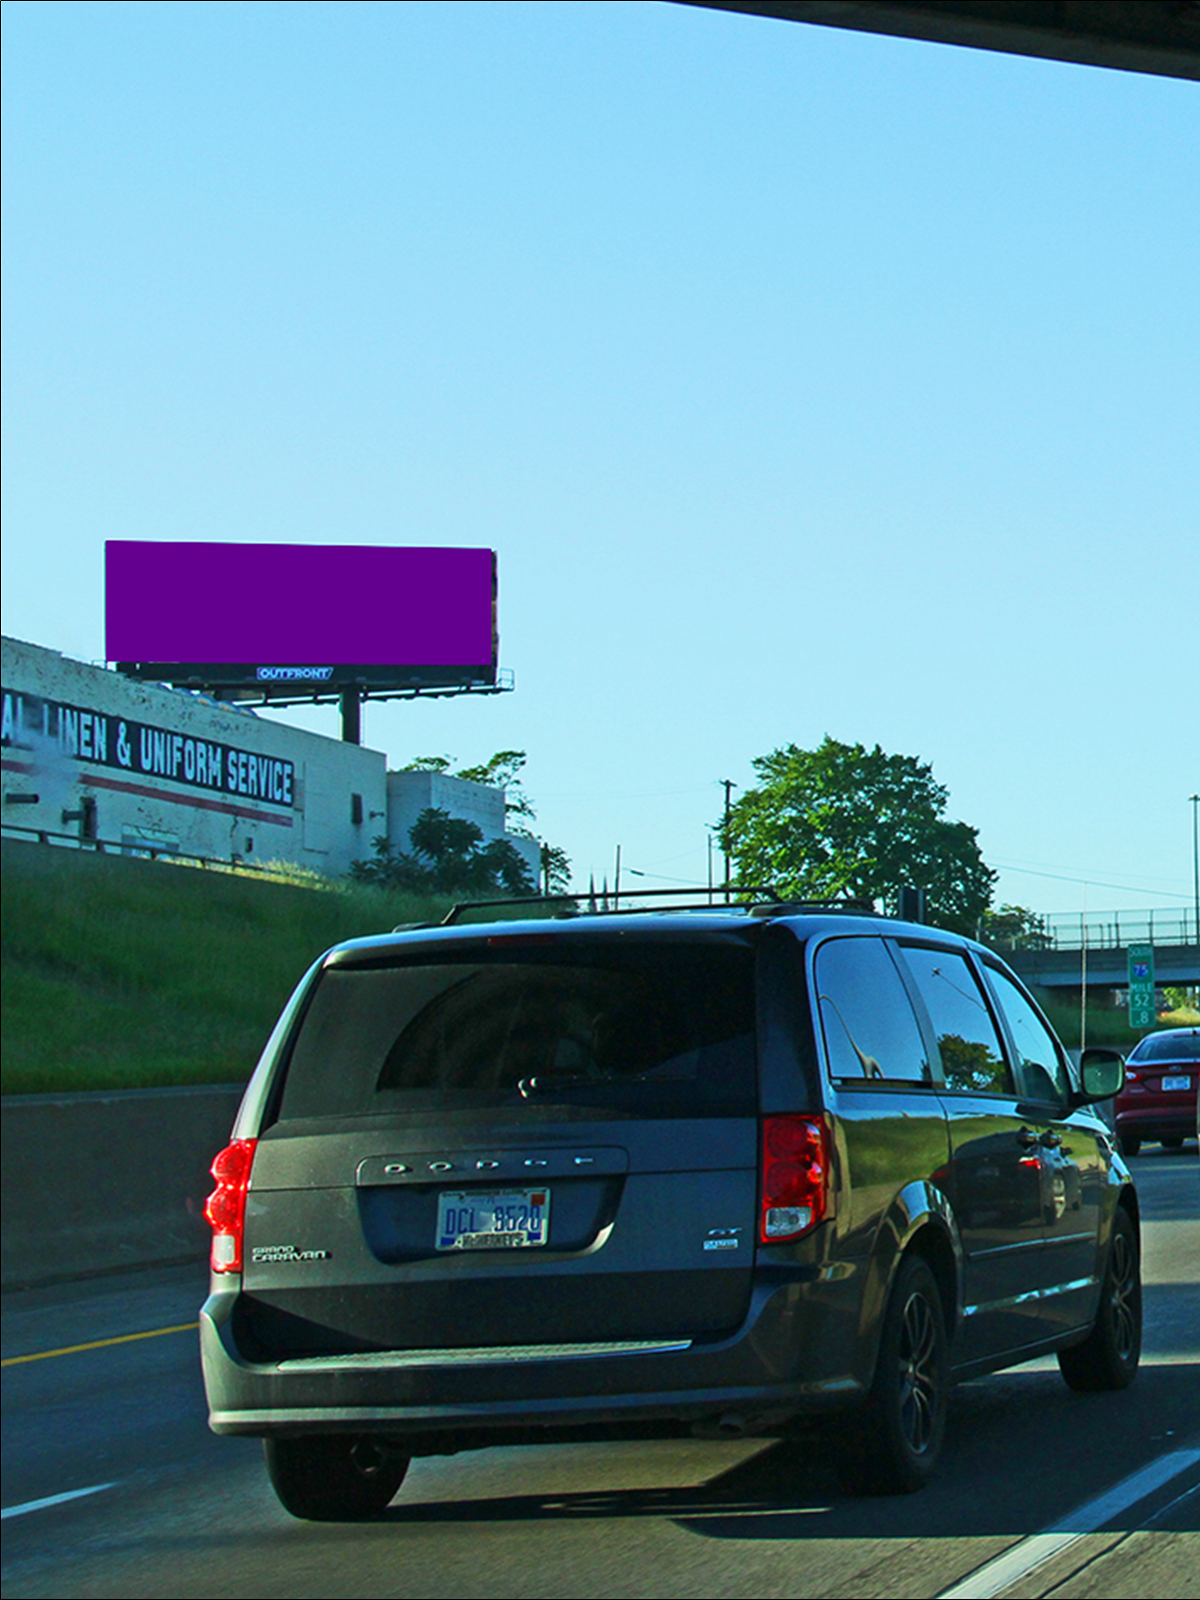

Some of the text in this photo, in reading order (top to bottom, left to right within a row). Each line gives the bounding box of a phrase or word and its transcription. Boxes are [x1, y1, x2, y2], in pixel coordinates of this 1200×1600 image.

[260, 668, 329, 679] OUTFRONT
[117, 721, 132, 767] &
[140, 727, 222, 787] UNIFORM
[227, 750, 292, 803] SERVICE
[1135, 964, 1149, 976] 75
[1130, 983, 1152, 993] MILE
[1134, 993, 1149, 1007] 52
[384, 1156, 594, 1174] DODGE
[445, 1207, 479, 1235] DCL
[252, 1250, 326, 1262] CARAVAN
